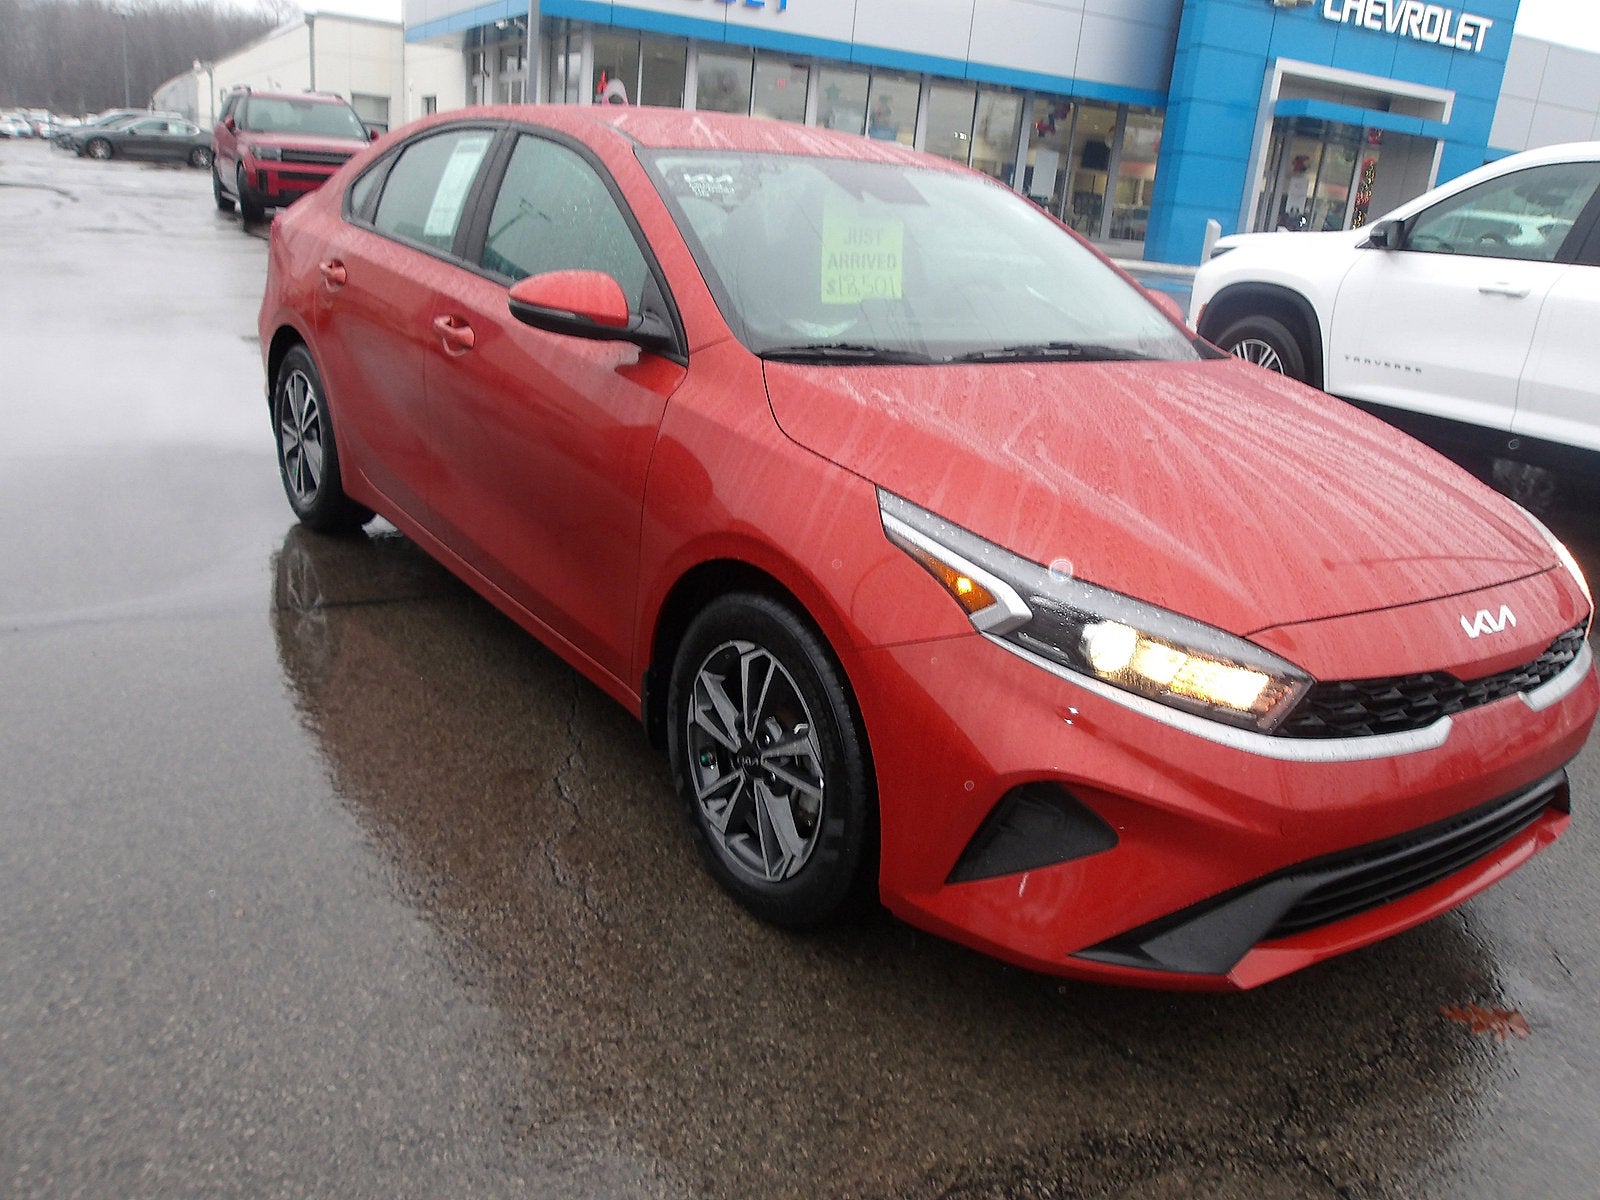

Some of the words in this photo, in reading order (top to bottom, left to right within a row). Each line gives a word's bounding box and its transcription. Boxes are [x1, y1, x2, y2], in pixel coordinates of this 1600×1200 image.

[1322, 0, 1493, 53] CHEVROLET
[844, 226, 884, 245] JUST
[827, 252, 897, 270] ARRIVED
[1460, 604, 1517, 639] KIA
